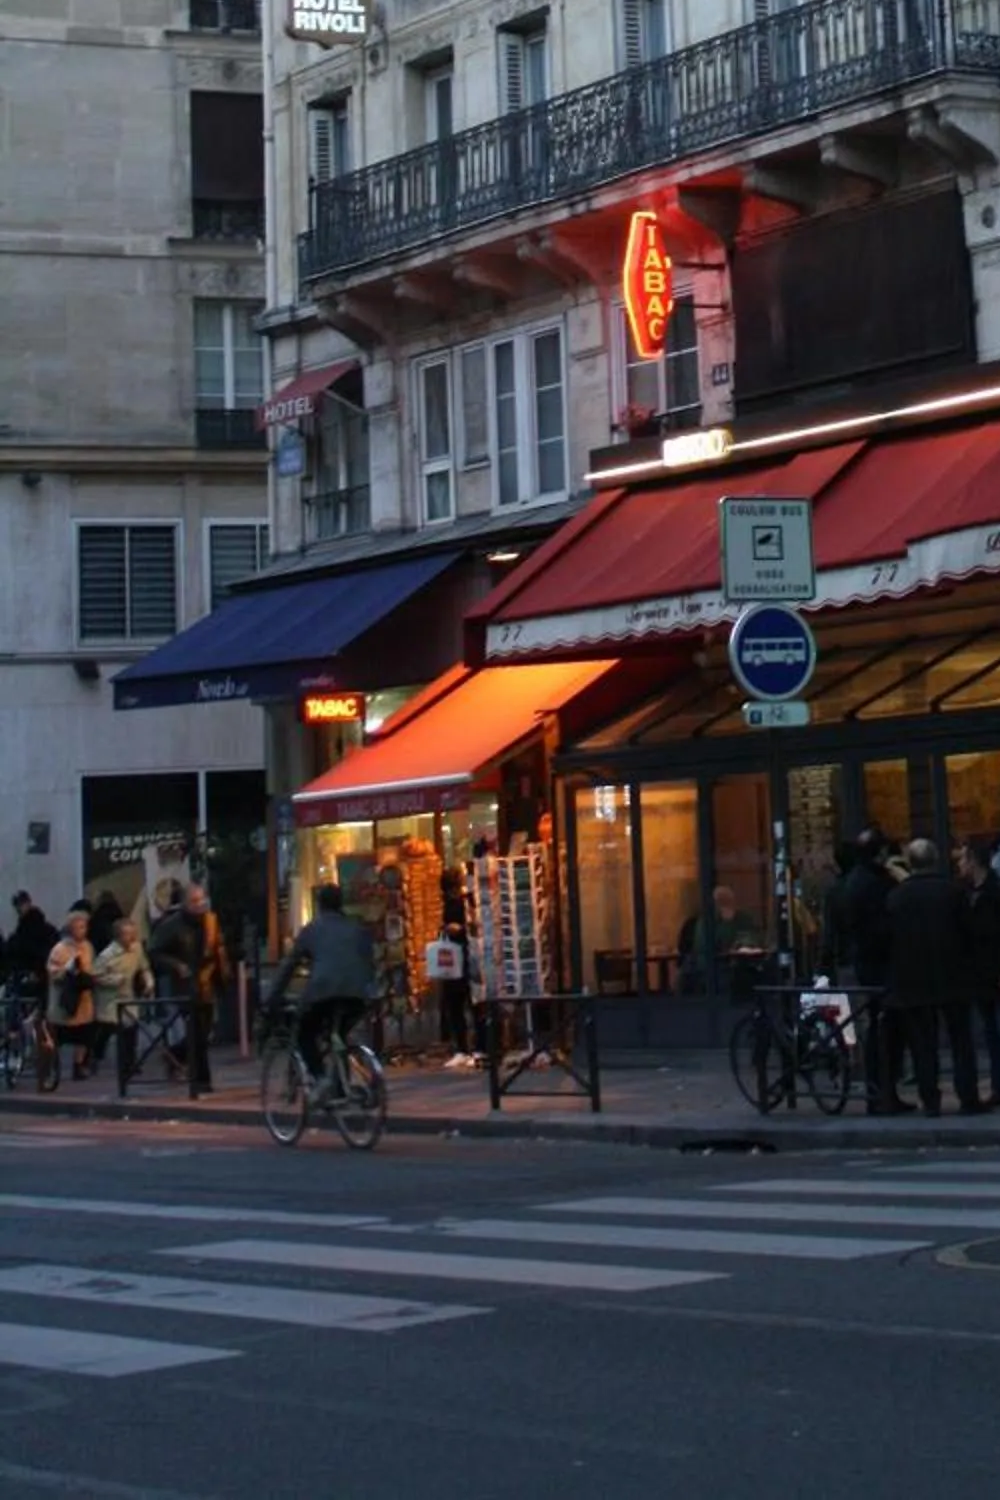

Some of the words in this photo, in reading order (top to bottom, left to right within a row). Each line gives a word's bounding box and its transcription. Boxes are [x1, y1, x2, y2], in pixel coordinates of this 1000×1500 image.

[293, 10, 367, 34] RIVOLI
[643, 225, 666, 340] TABAC
[264, 396, 315, 422] HOTEL
[305, 698, 356, 718] TABAC
